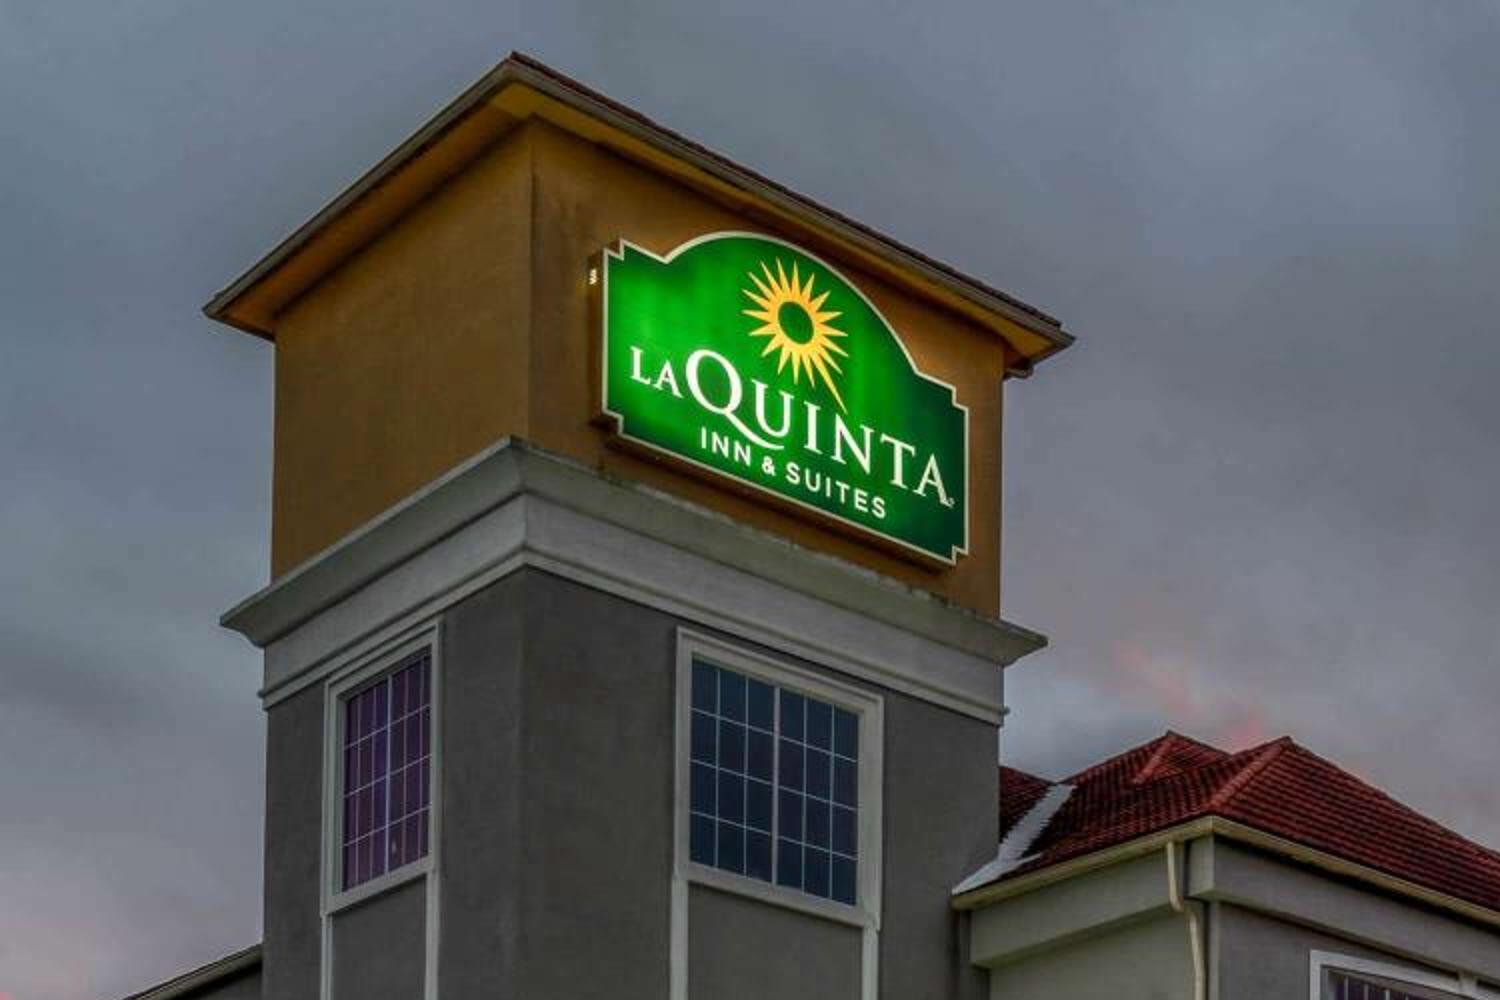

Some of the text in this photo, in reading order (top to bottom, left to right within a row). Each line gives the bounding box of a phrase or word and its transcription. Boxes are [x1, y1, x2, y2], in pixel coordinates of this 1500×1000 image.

[685, 349, 952, 508] QUINTA
[701, 427, 887, 519] INN & SUITES
